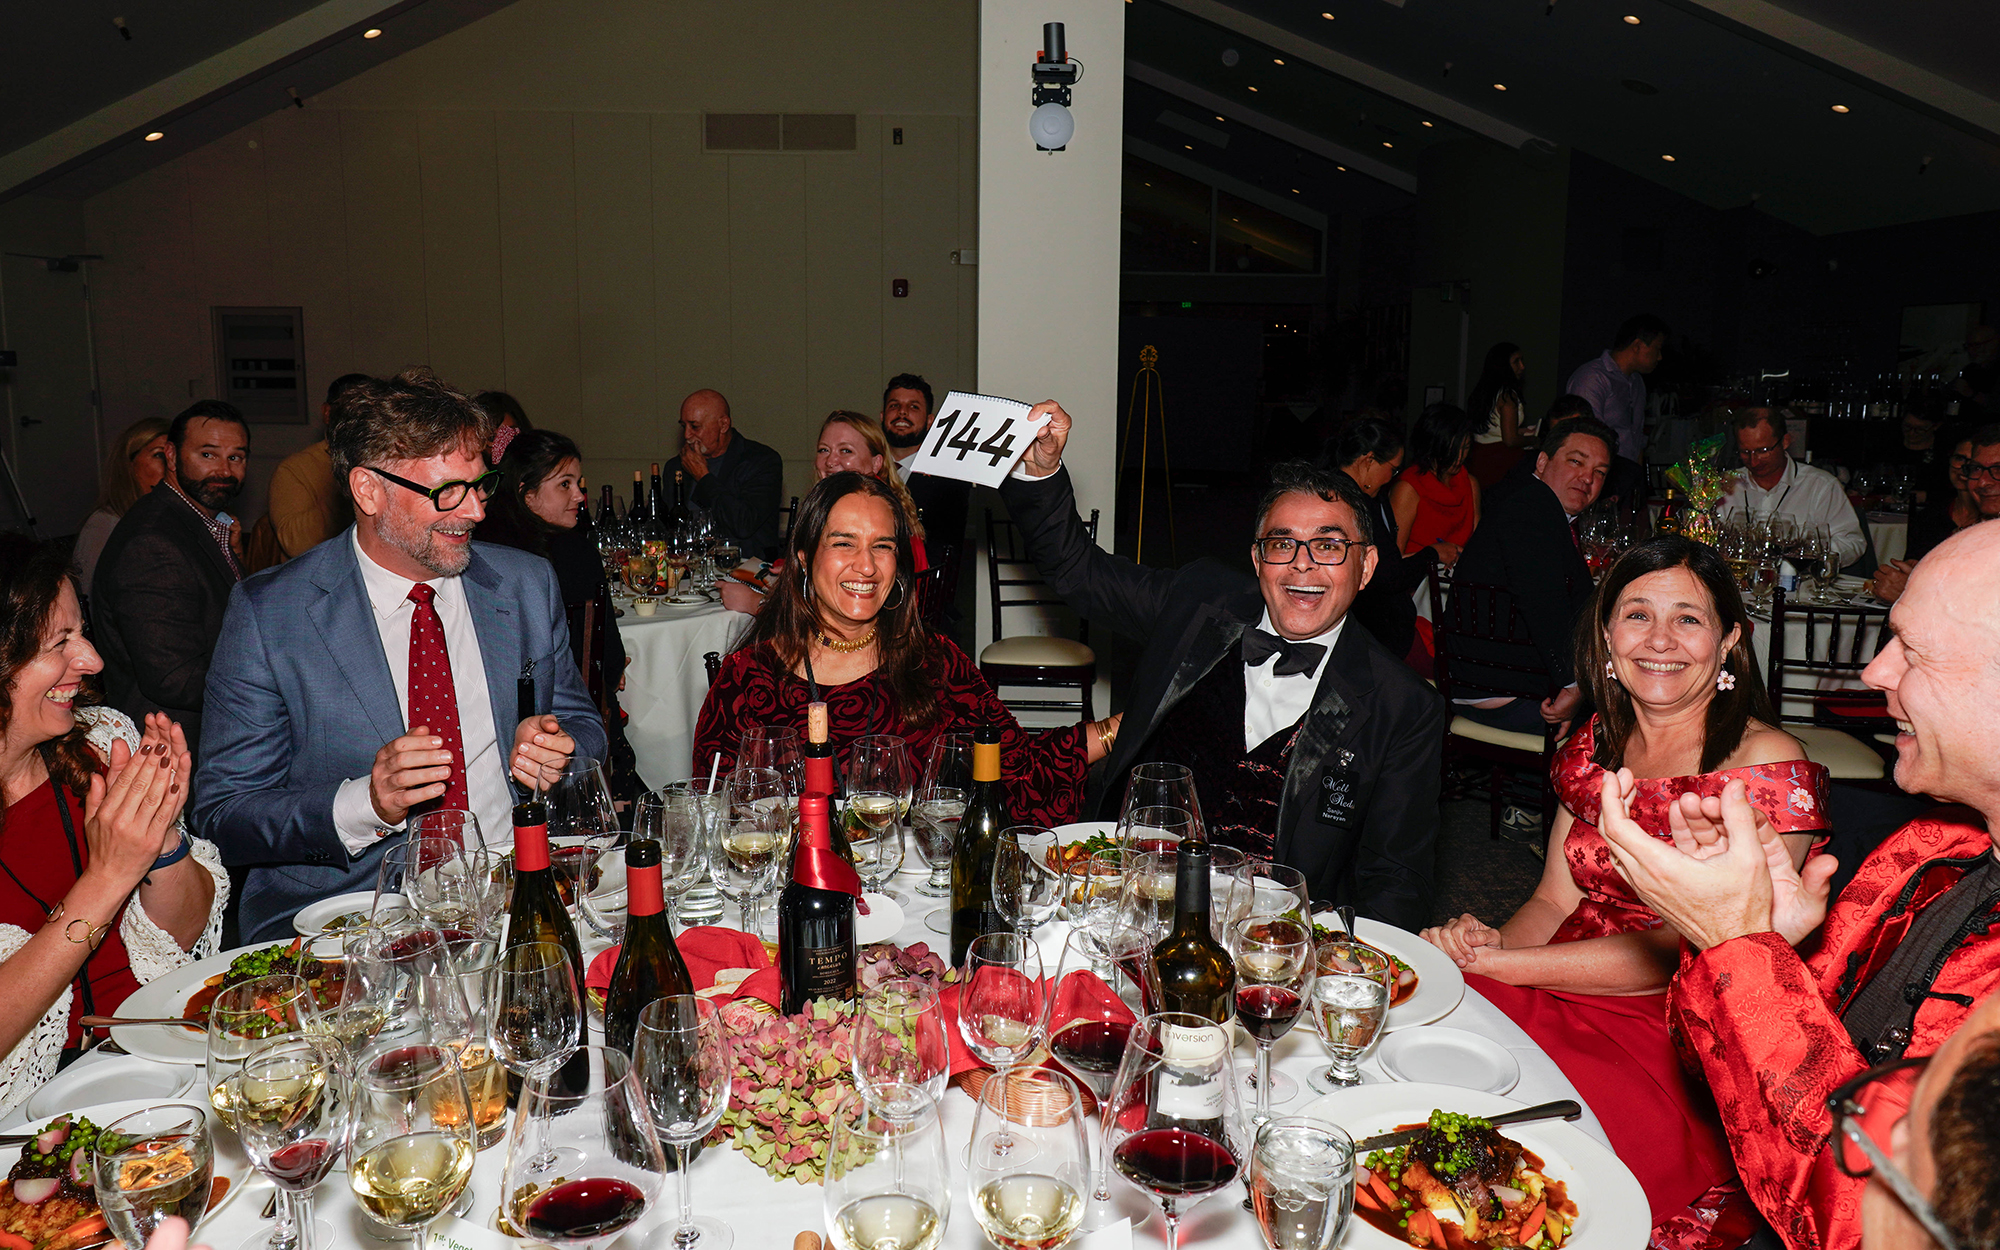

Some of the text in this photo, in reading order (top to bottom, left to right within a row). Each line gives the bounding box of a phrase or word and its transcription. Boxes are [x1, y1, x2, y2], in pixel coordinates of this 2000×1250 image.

[930, 409, 1016, 467] 144
[1322, 775, 1350, 793] Well
[808, 951, 848, 965] TEMPO
